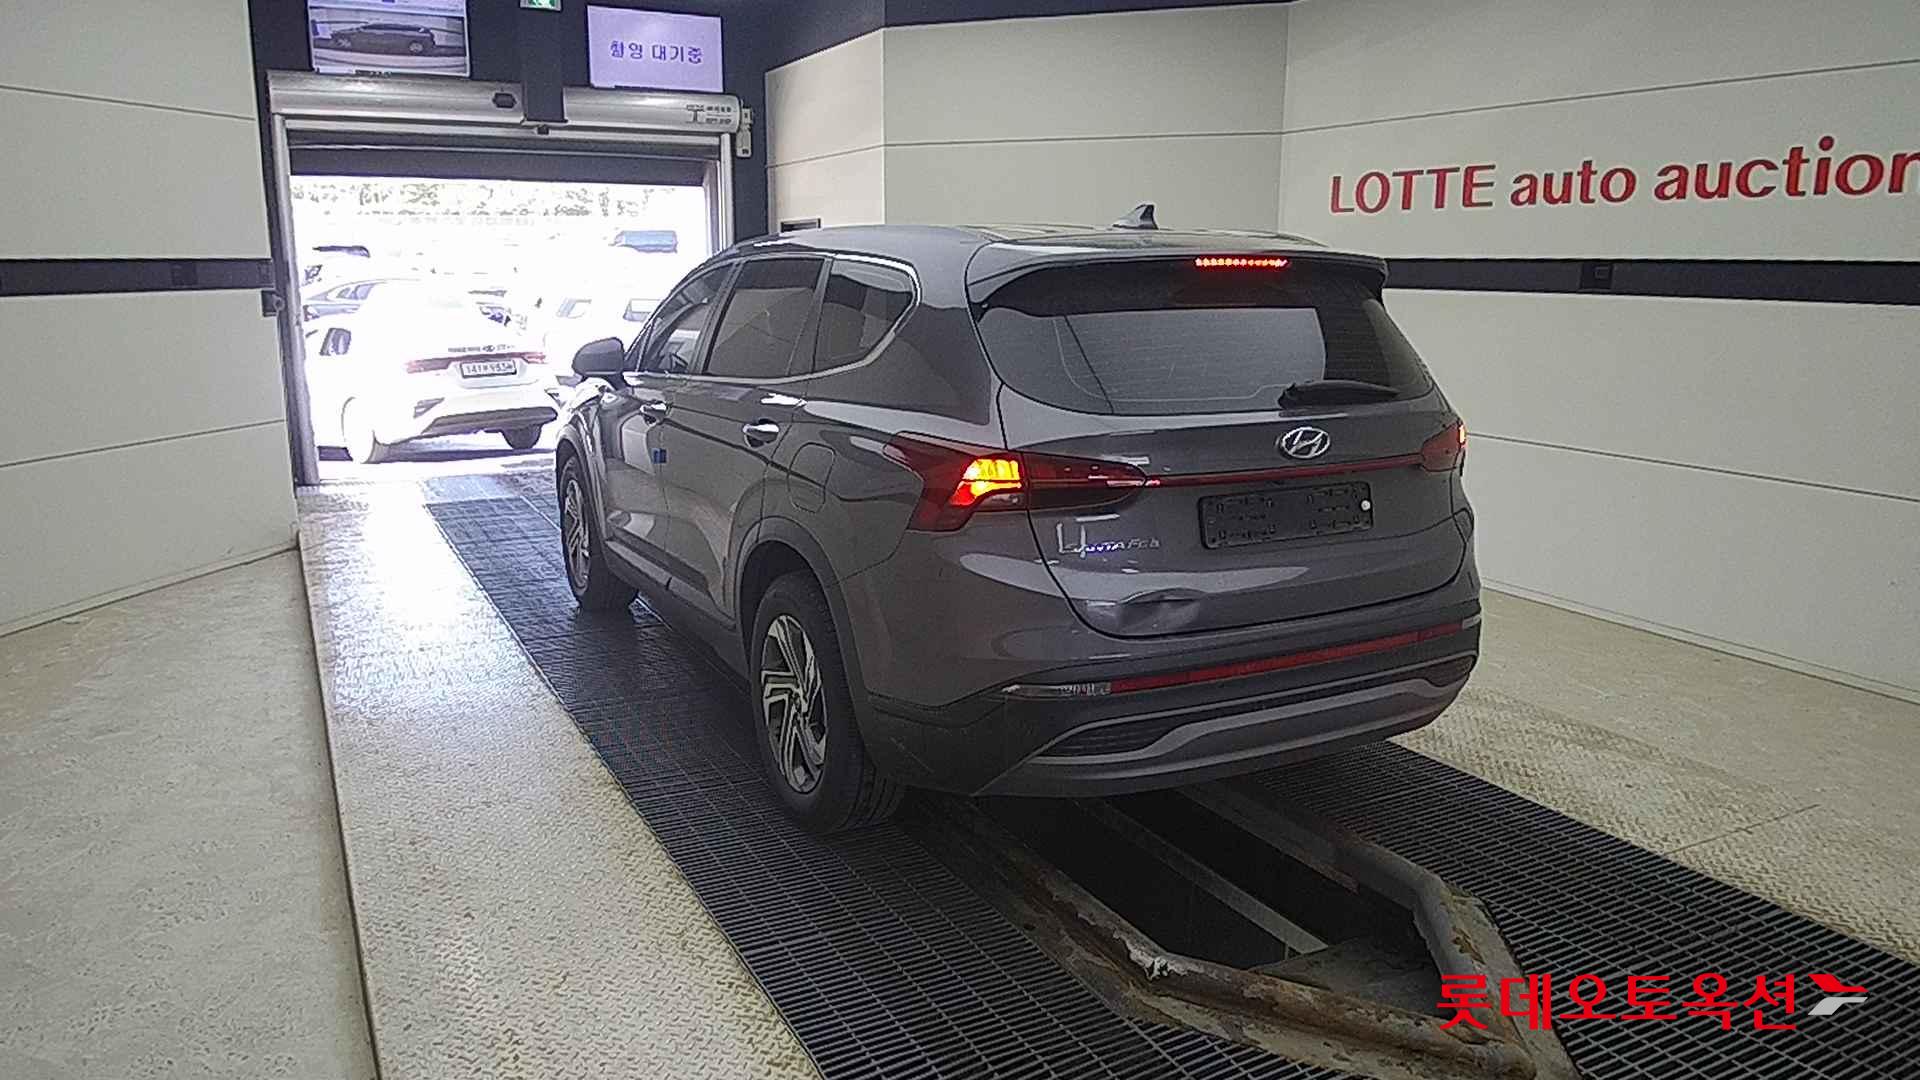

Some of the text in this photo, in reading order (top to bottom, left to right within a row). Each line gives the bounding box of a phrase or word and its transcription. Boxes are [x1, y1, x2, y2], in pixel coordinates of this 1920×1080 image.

[1331, 135, 1920, 213] LOTTE auto auction
